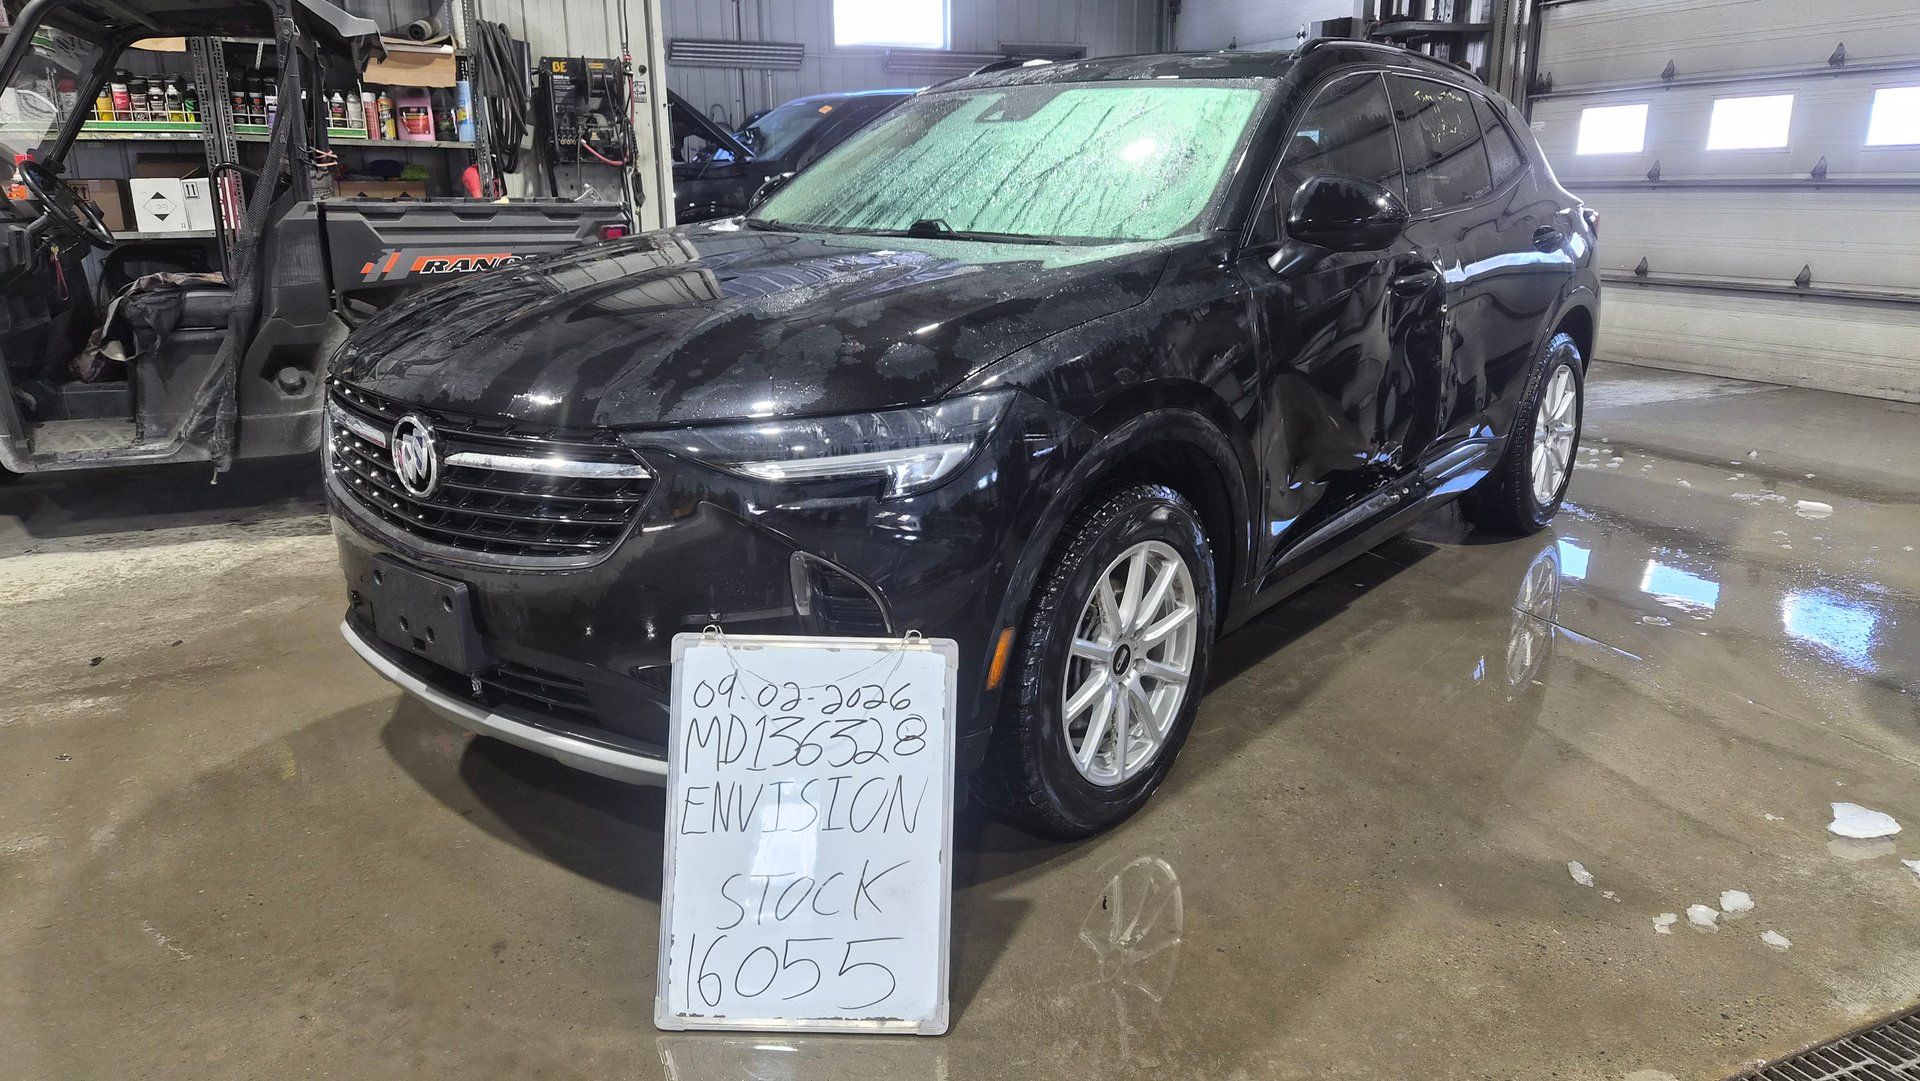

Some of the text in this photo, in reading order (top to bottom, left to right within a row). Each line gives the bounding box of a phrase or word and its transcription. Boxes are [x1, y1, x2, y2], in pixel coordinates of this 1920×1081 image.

[684, 713, 928, 774] MD136328
[681, 774, 929, 835] ENVISION
[716, 859, 912, 930] STOCK
[686, 933, 905, 1010] 16055
